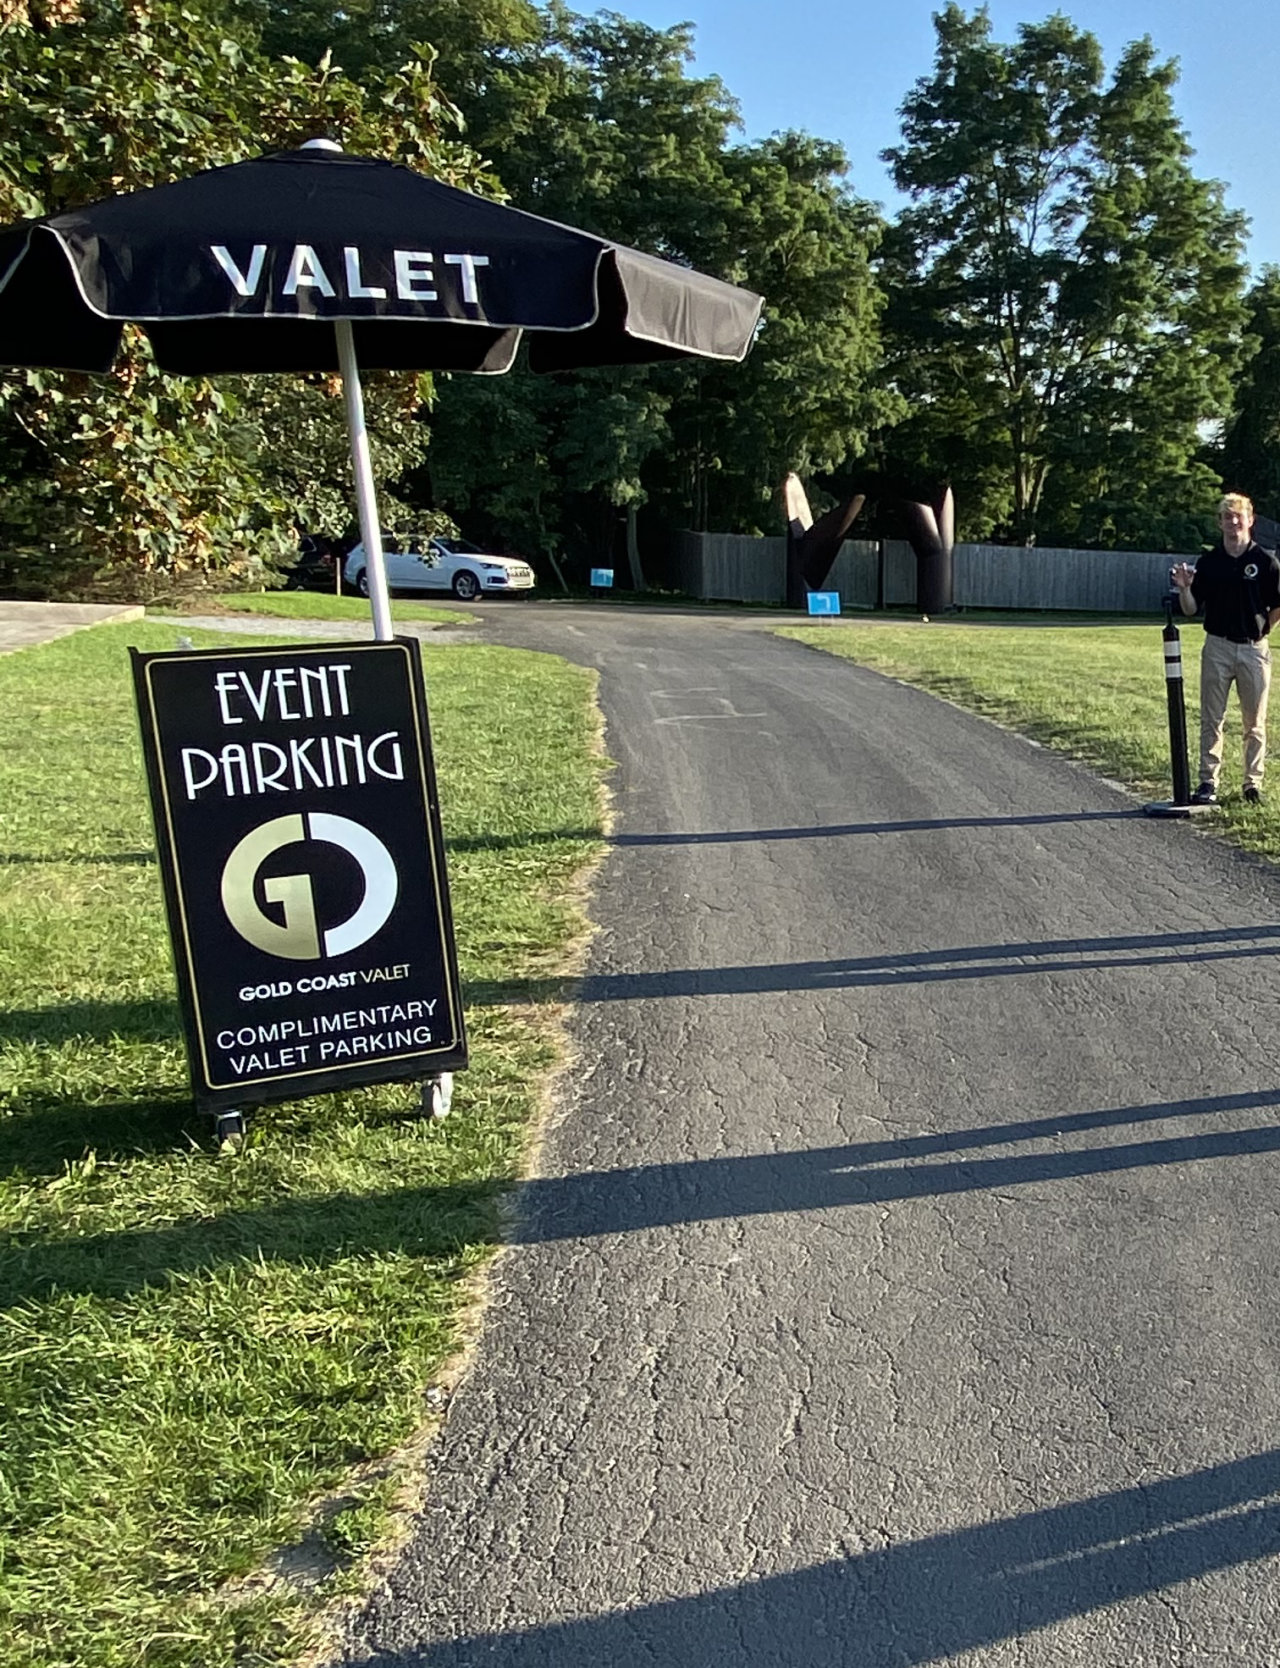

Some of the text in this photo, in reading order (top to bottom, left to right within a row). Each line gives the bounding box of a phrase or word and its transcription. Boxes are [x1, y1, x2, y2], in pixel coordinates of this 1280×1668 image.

[210, 244, 489, 304] VALET
[214, 664, 351, 725] EVENT
[181, 731, 405, 800] PARKING
[238, 963, 411, 1001] GOLD COAST VALET
[216, 998, 438, 1050] COMPLIMENTARY
[229, 1026, 432, 1075] VALET PARKING
